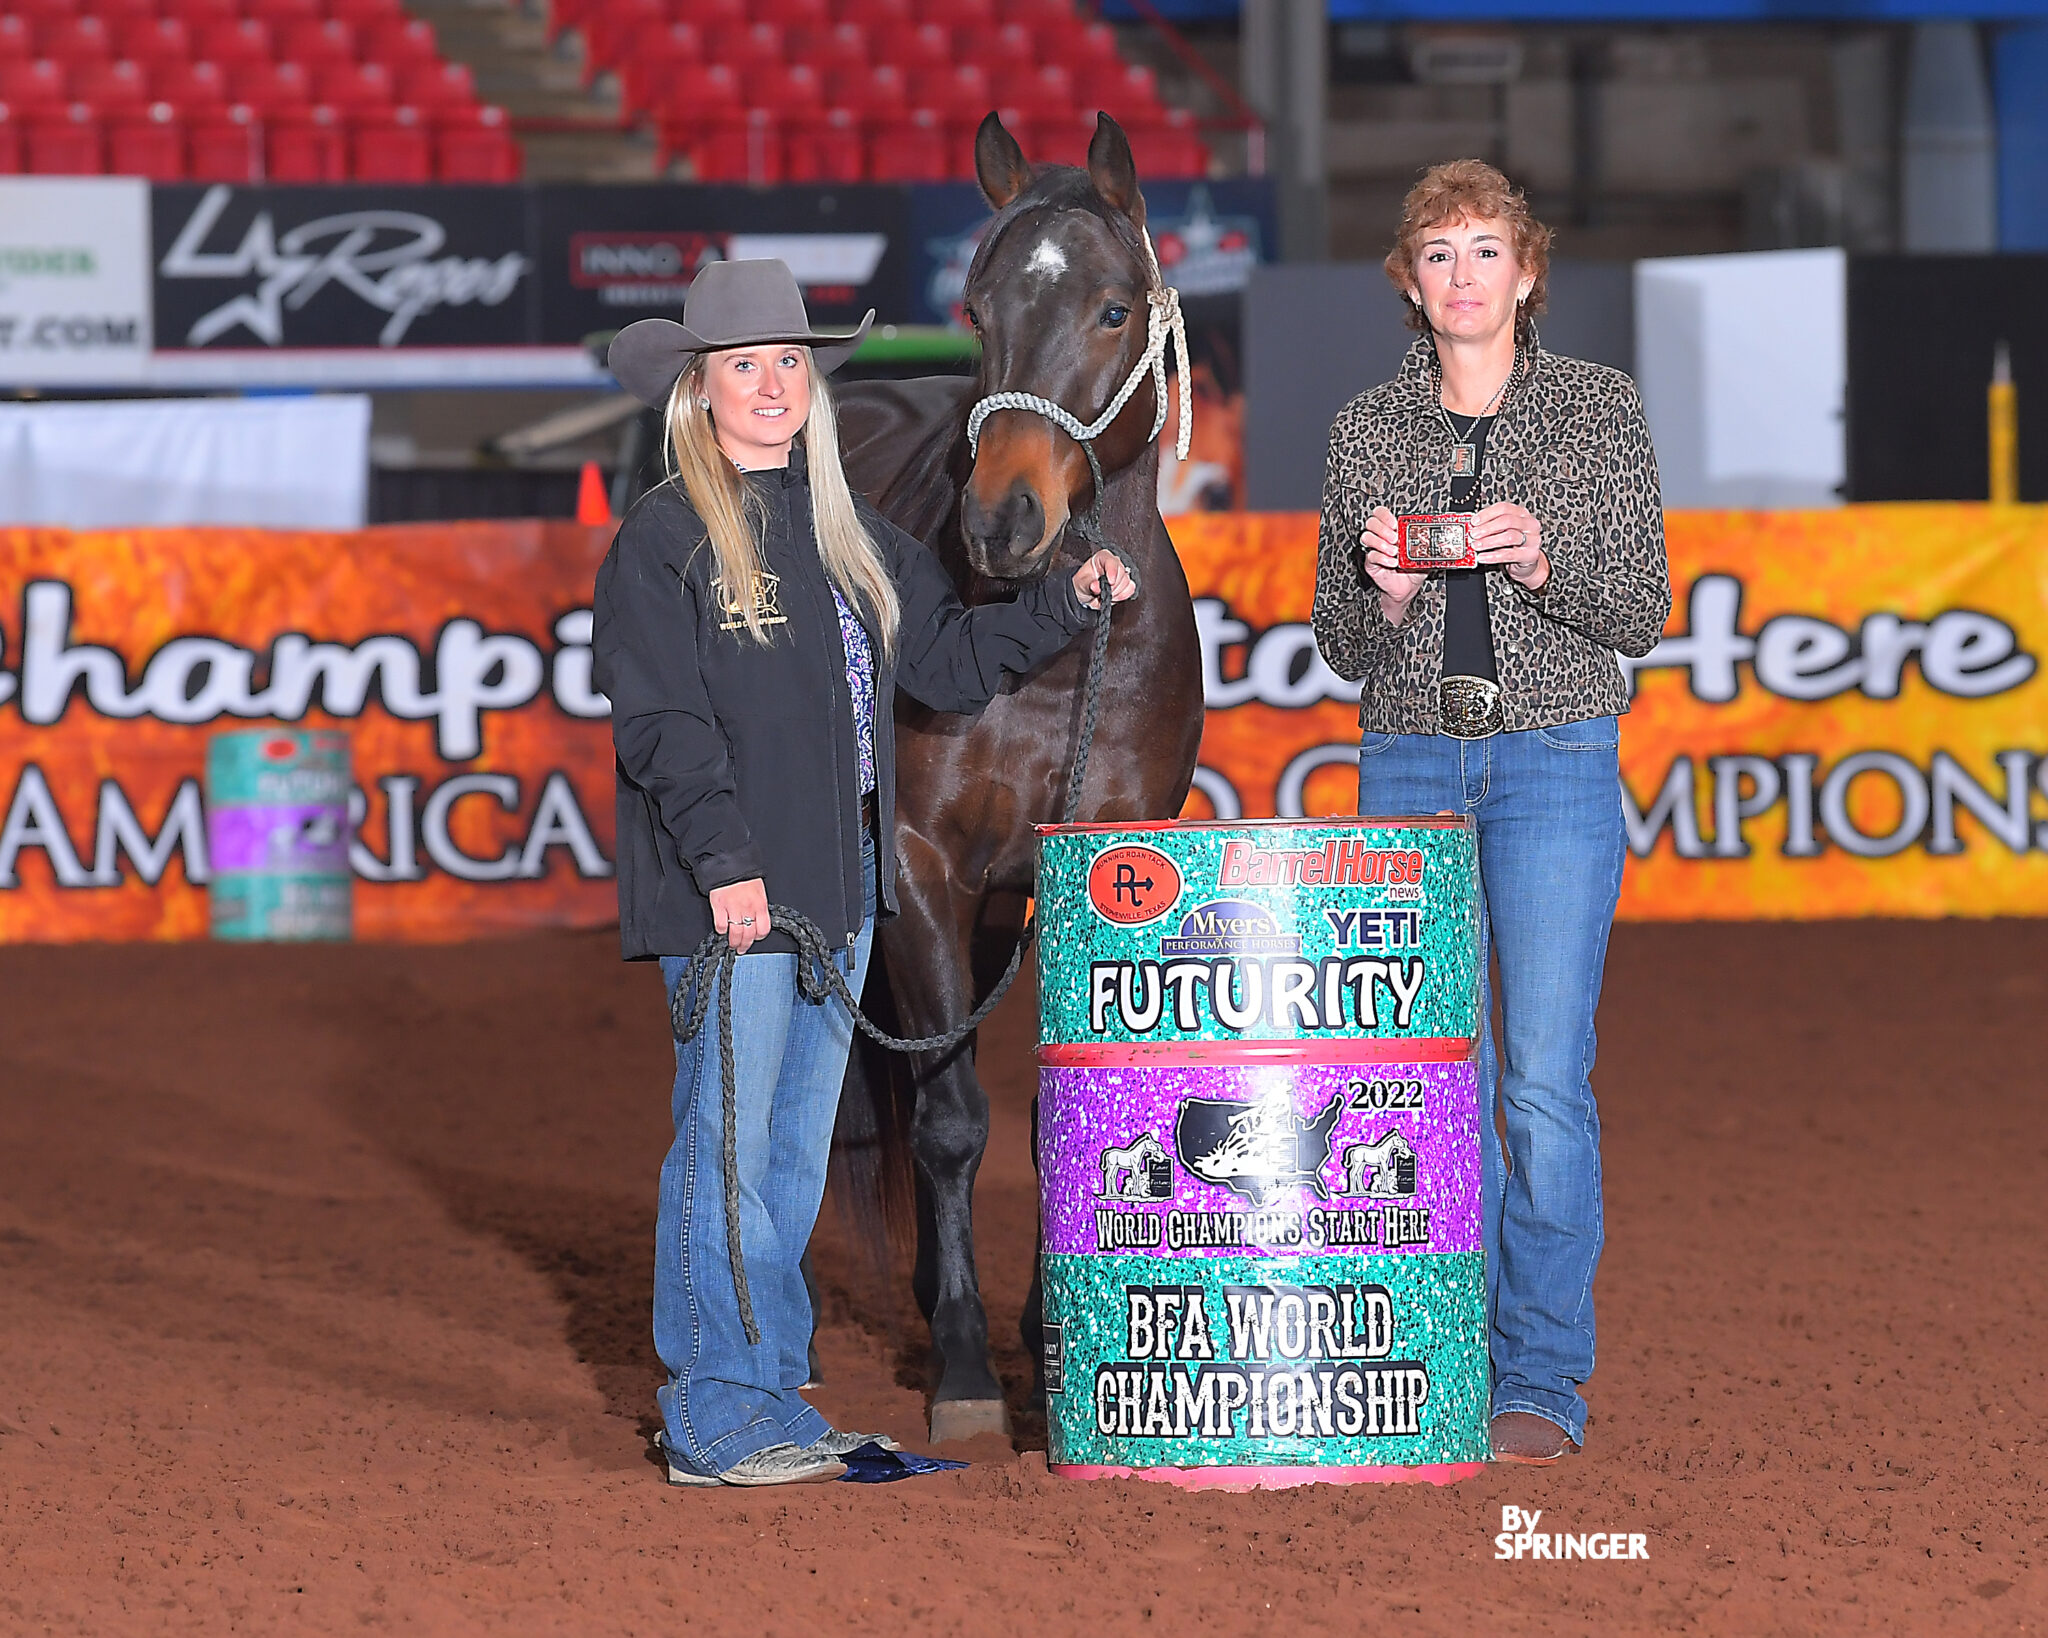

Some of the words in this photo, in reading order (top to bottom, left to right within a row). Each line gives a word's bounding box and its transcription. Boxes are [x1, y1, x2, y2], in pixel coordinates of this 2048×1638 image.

[0, 579, 612, 760] hampi
[0, 764, 613, 888] AMICA
[1096, 851, 1125, 871] RUNNING
[1126, 851, 1147, 860] ROAN
[1148, 854, 1166, 870] TACK
[1144, 900, 1166, 917] TEXAS
[1389, 886, 1420, 899] news
[1192, 911, 1270, 942] Myers
[1327, 912, 1420, 945] YETI
[1166, 940, 1248, 951] PERFORMANCE
[1252, 940, 1297, 950] HORSES
[1088, 957, 1425, 1034] FUTURITY
[1349, 1081, 1423, 1109] 2022
[1095, 1209, 1162, 1249] WORLD
[1167, 1209, 1302, 1249] CHAMPIONS
[1308, 1208, 1380, 1248] START
[1383, 1206, 1430, 1248] HERE
[1126, 1285, 1213, 1360] BFA
[1223, 1284, 1396, 1360] WORLD
[1097, 1360, 1430, 1437] CHAMPIONSHIP
